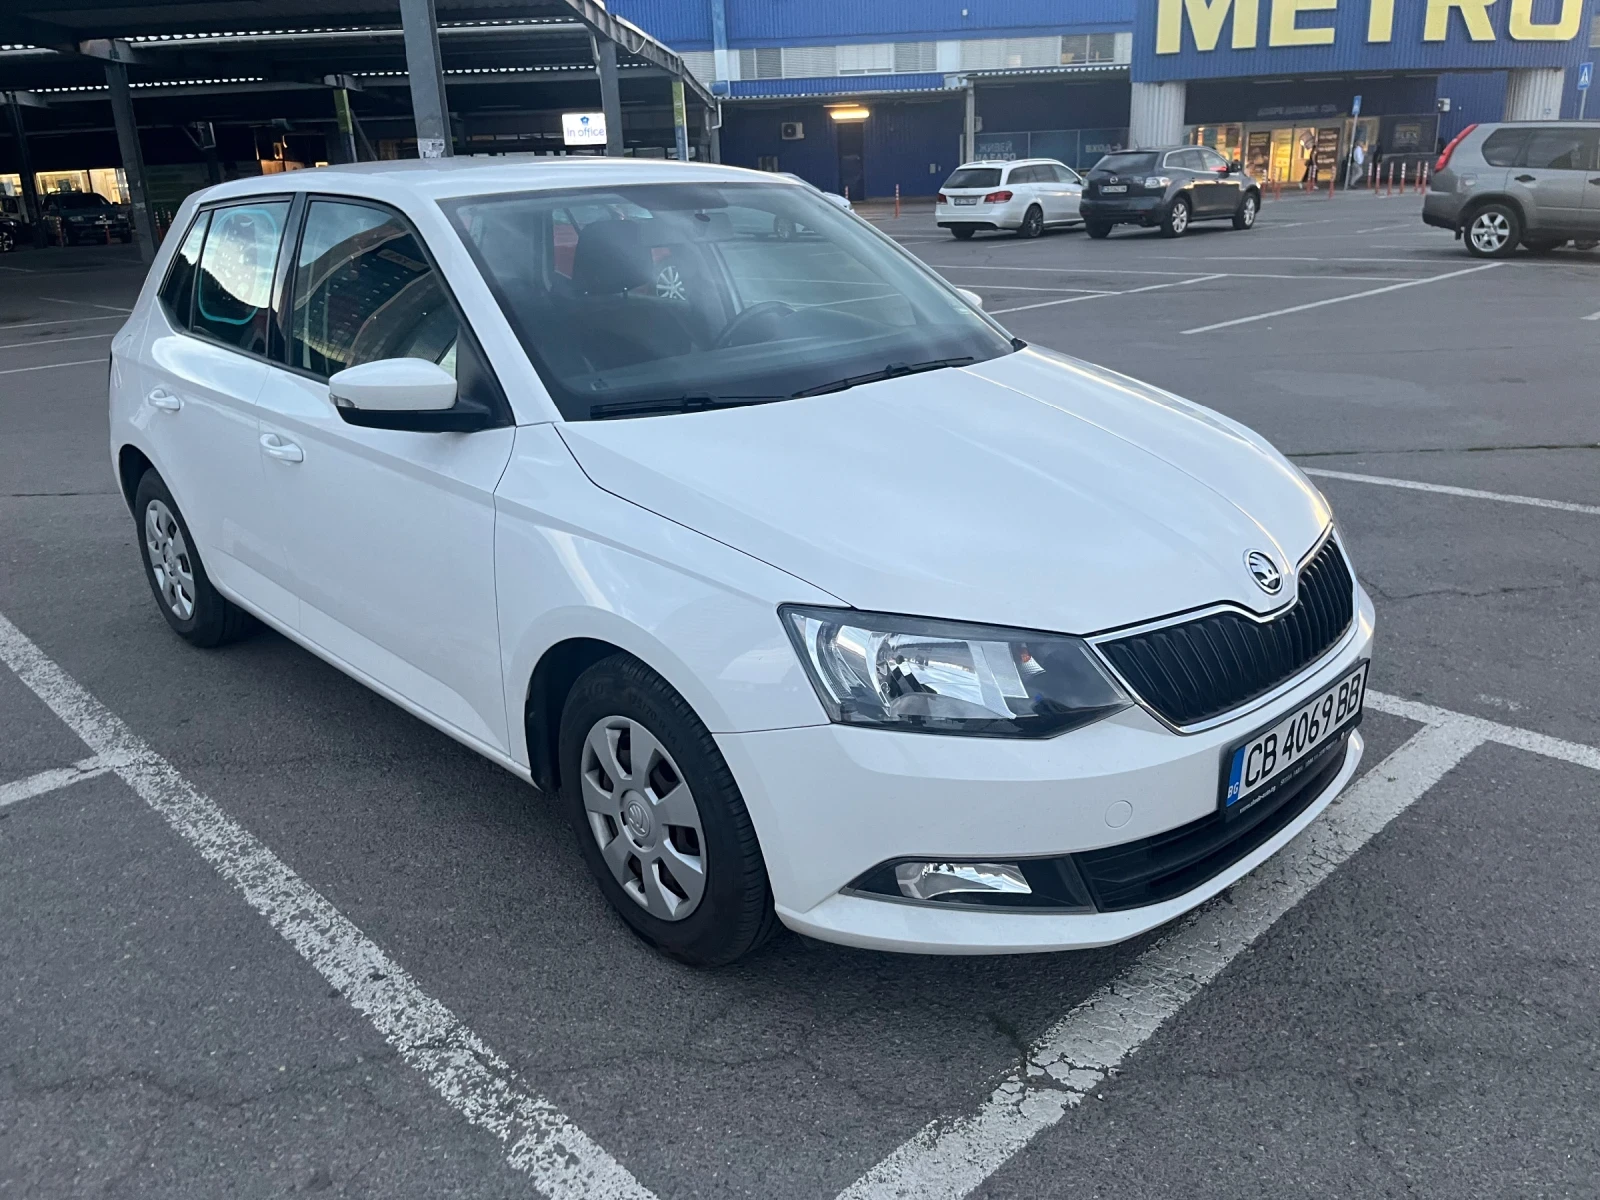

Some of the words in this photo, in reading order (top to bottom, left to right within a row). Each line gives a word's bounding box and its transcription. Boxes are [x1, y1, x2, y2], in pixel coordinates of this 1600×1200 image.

[578, 126, 605, 138] office
[1227, 781, 1240, 799] BG
[1244, 733, 1278, 788] CB
[1282, 694, 1334, 761] 4069
[1335, 673, 1361, 725] BB
